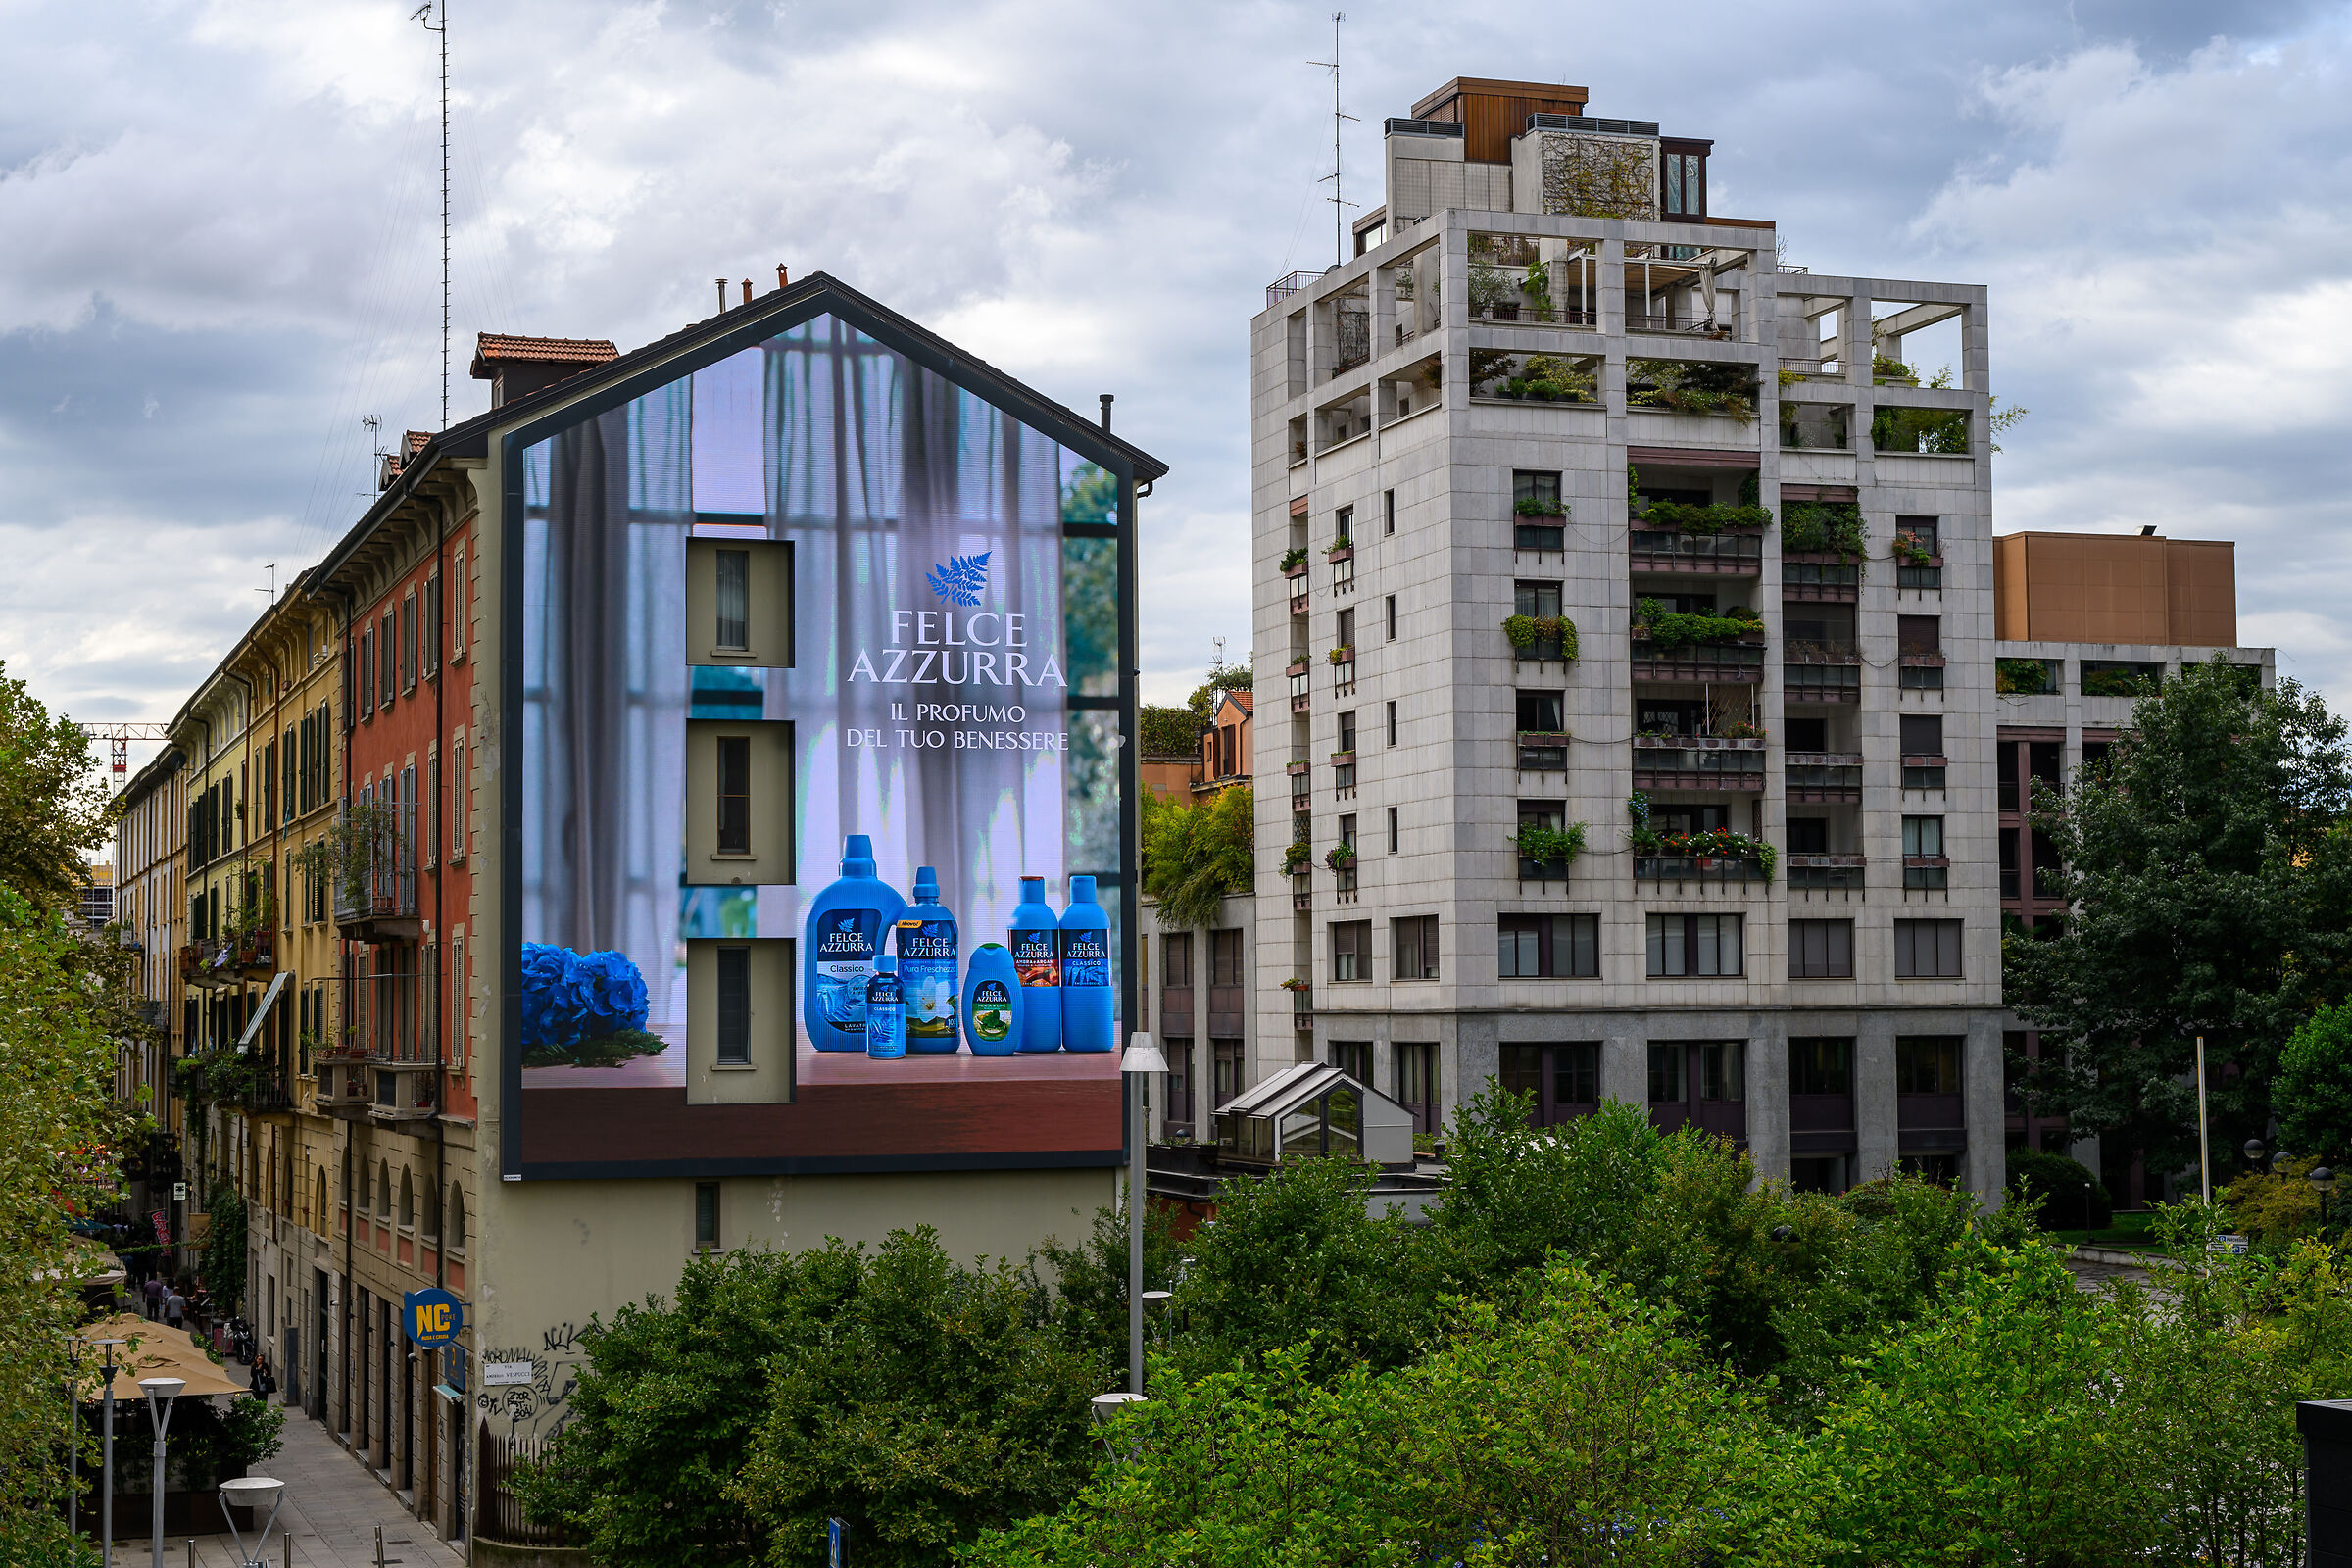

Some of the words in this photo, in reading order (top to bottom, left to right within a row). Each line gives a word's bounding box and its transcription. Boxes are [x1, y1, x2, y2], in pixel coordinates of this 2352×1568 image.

[891, 610, 1028, 647] FELCE
[847, 647, 1068, 687] AZZURRA
[891, 703, 908, 721] IL
[916, 703, 1026, 723] PROFUMO
[847, 728, 888, 748] DEL
[896, 729, 946, 749] TUO
[954, 730, 1069, 752] BENESSERE
[829, 932, 864, 943] FELCE
[912, 937, 949, 948] FELCE
[819, 943, 874, 953] AZZURRA
[903, 947, 956, 957] AZZURRA
[1021, 943, 1048, 952] FELCE
[1072, 942, 1100, 951] FELCE
[829, 964, 865, 973] Classico
[903, 964, 920, 973] Pura
[416, 1303, 451, 1339] NC
